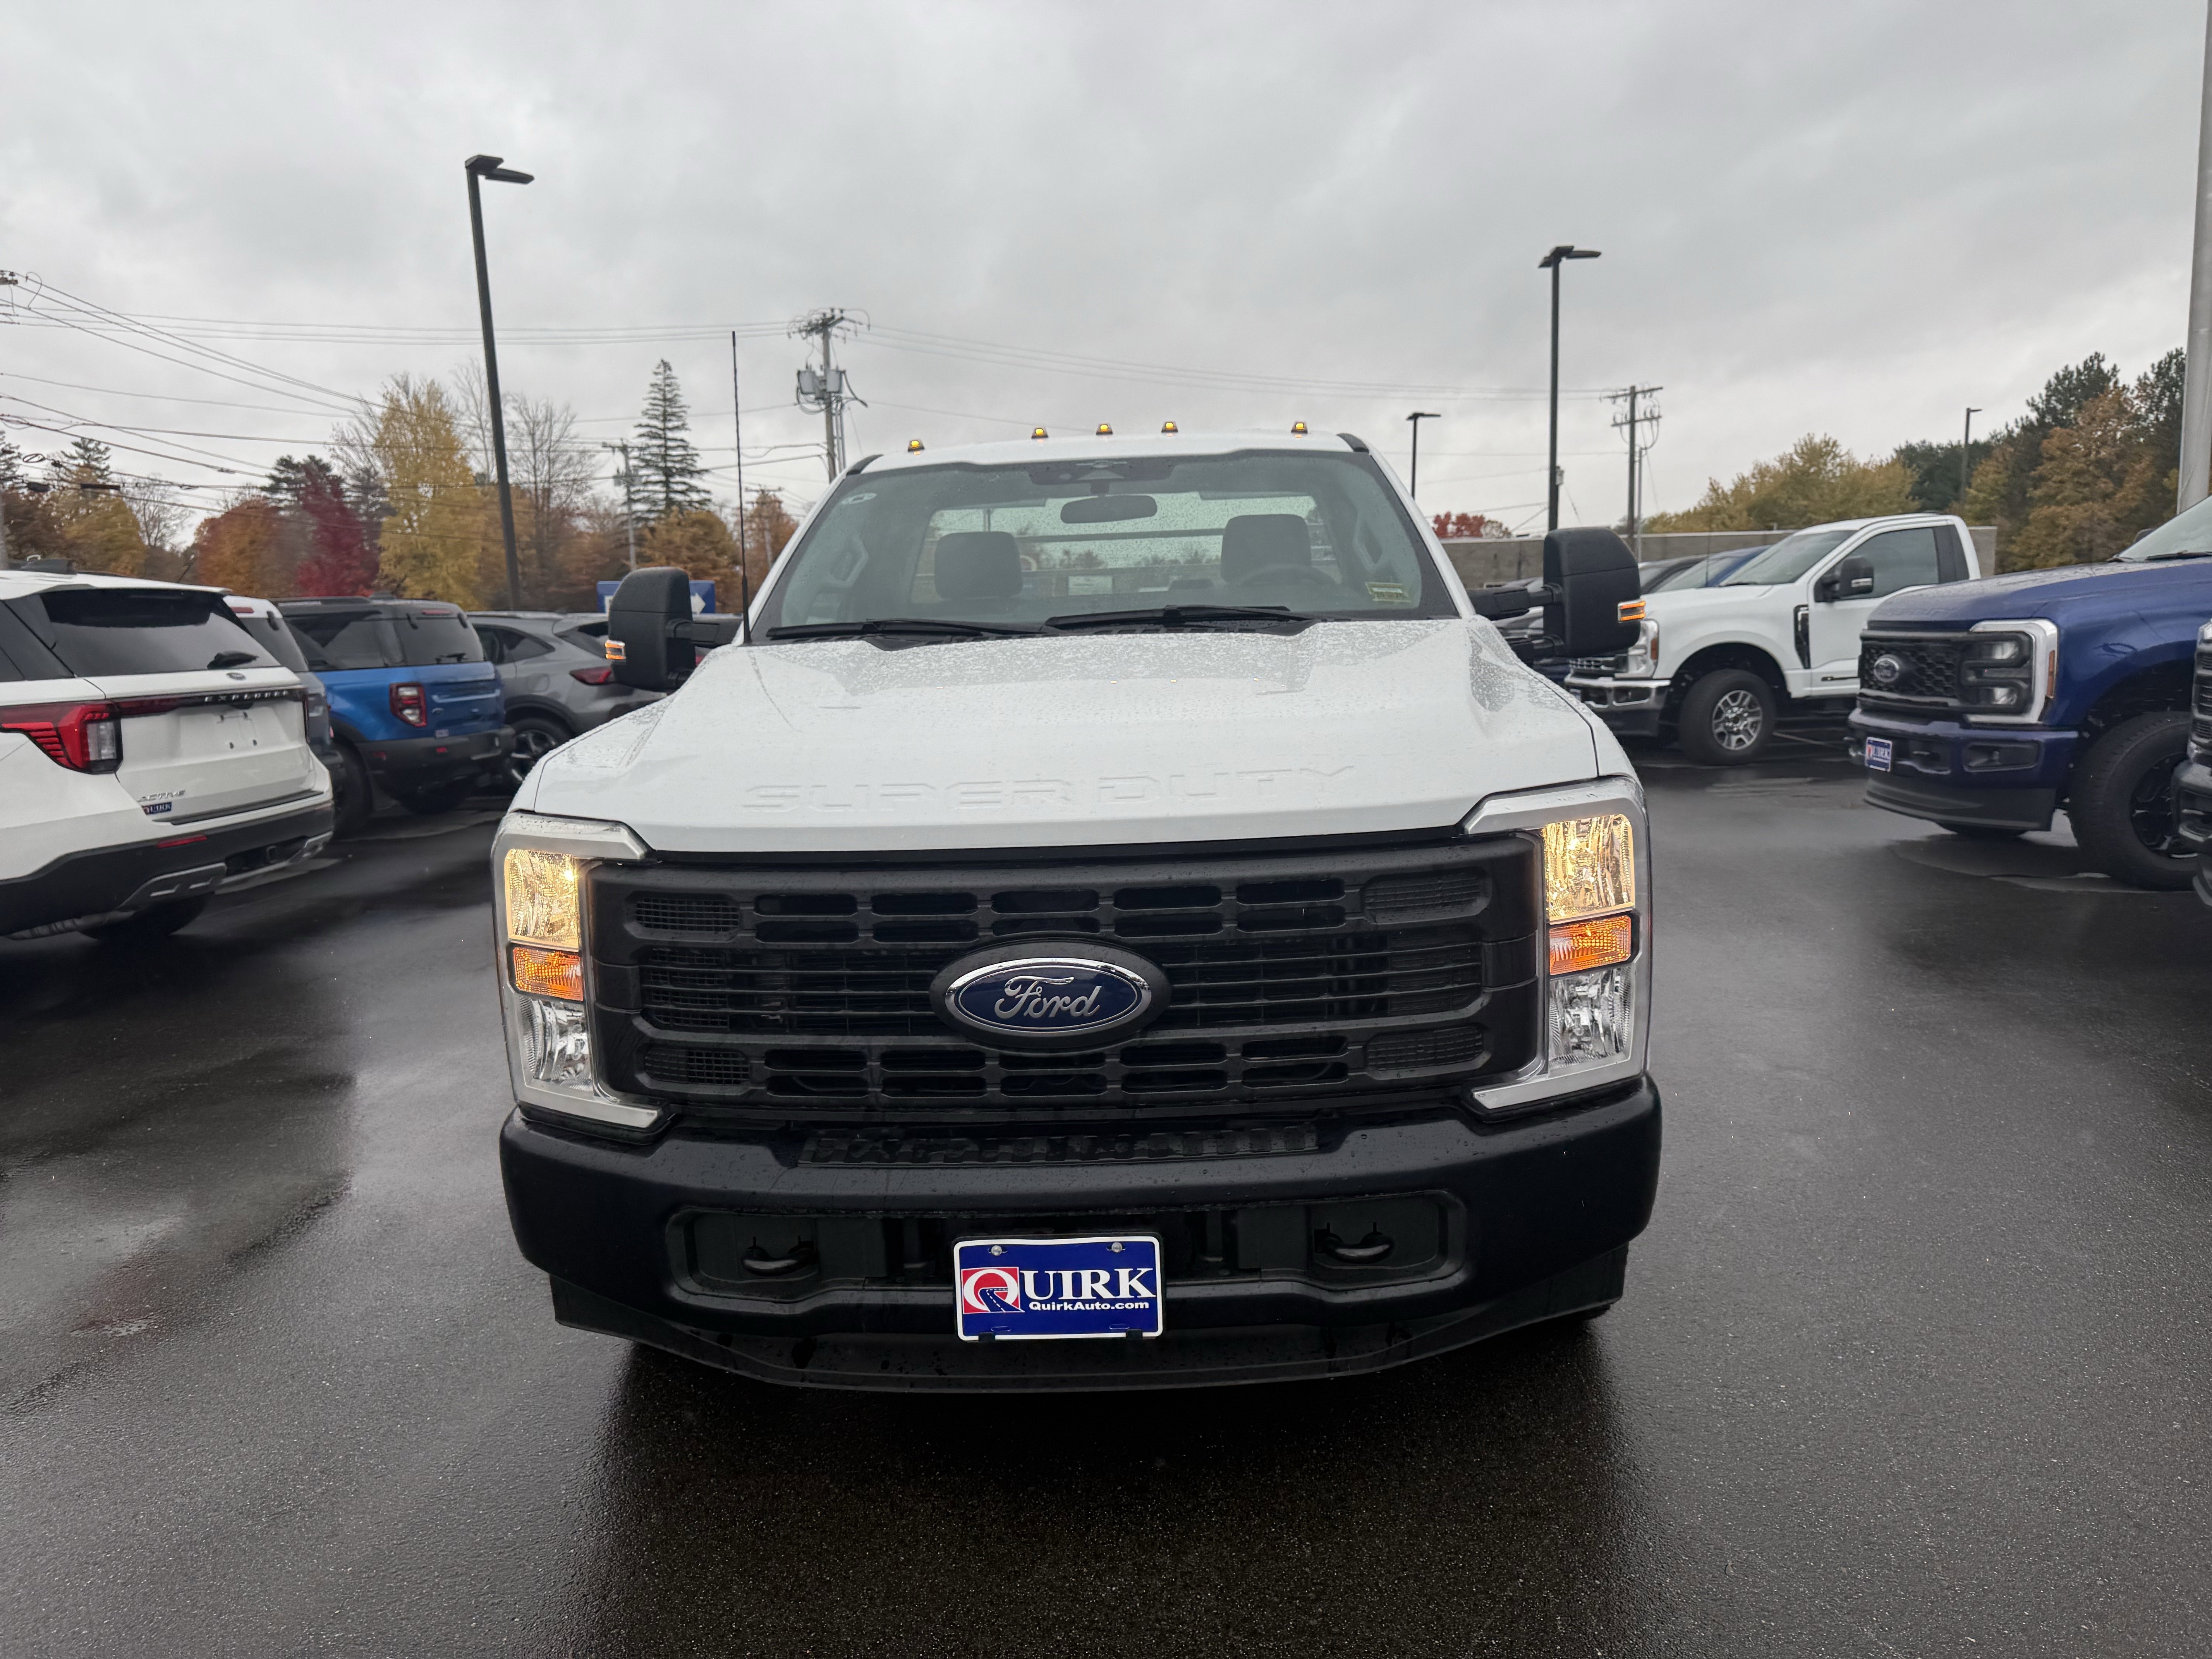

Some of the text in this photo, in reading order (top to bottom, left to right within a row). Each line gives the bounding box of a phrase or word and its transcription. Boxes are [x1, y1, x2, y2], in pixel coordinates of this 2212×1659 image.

[205, 690, 288, 702] EXPLORER
[137, 790, 185, 802] ACTIVE
[742, 765, 1355, 812] SUPER DUTY
[994, 975, 1102, 1019] Ford
[963, 1267, 1156, 1313] QUIRK
[1029, 1301, 1149, 1311] QuirkAuto.com
